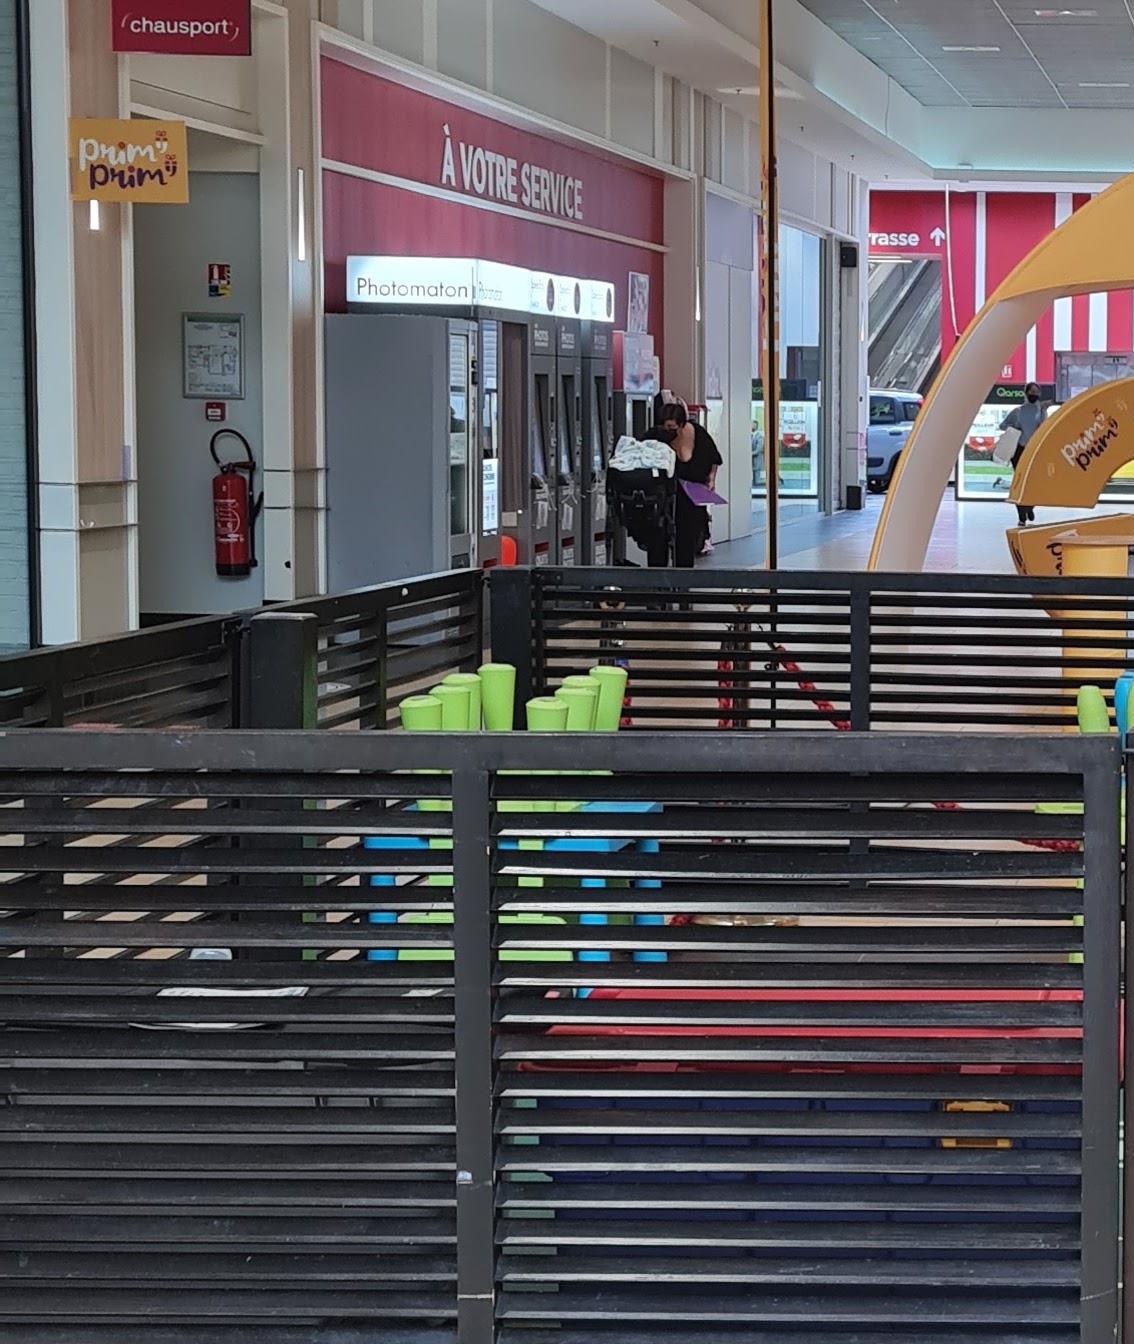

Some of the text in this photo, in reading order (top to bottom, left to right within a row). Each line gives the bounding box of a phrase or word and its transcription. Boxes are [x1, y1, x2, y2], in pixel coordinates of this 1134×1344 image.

[130, 16, 229, 37] chausport
[441, 123, 584, 220] À VOTRE SERVICE
[357, 277, 468, 298] Photomaton
